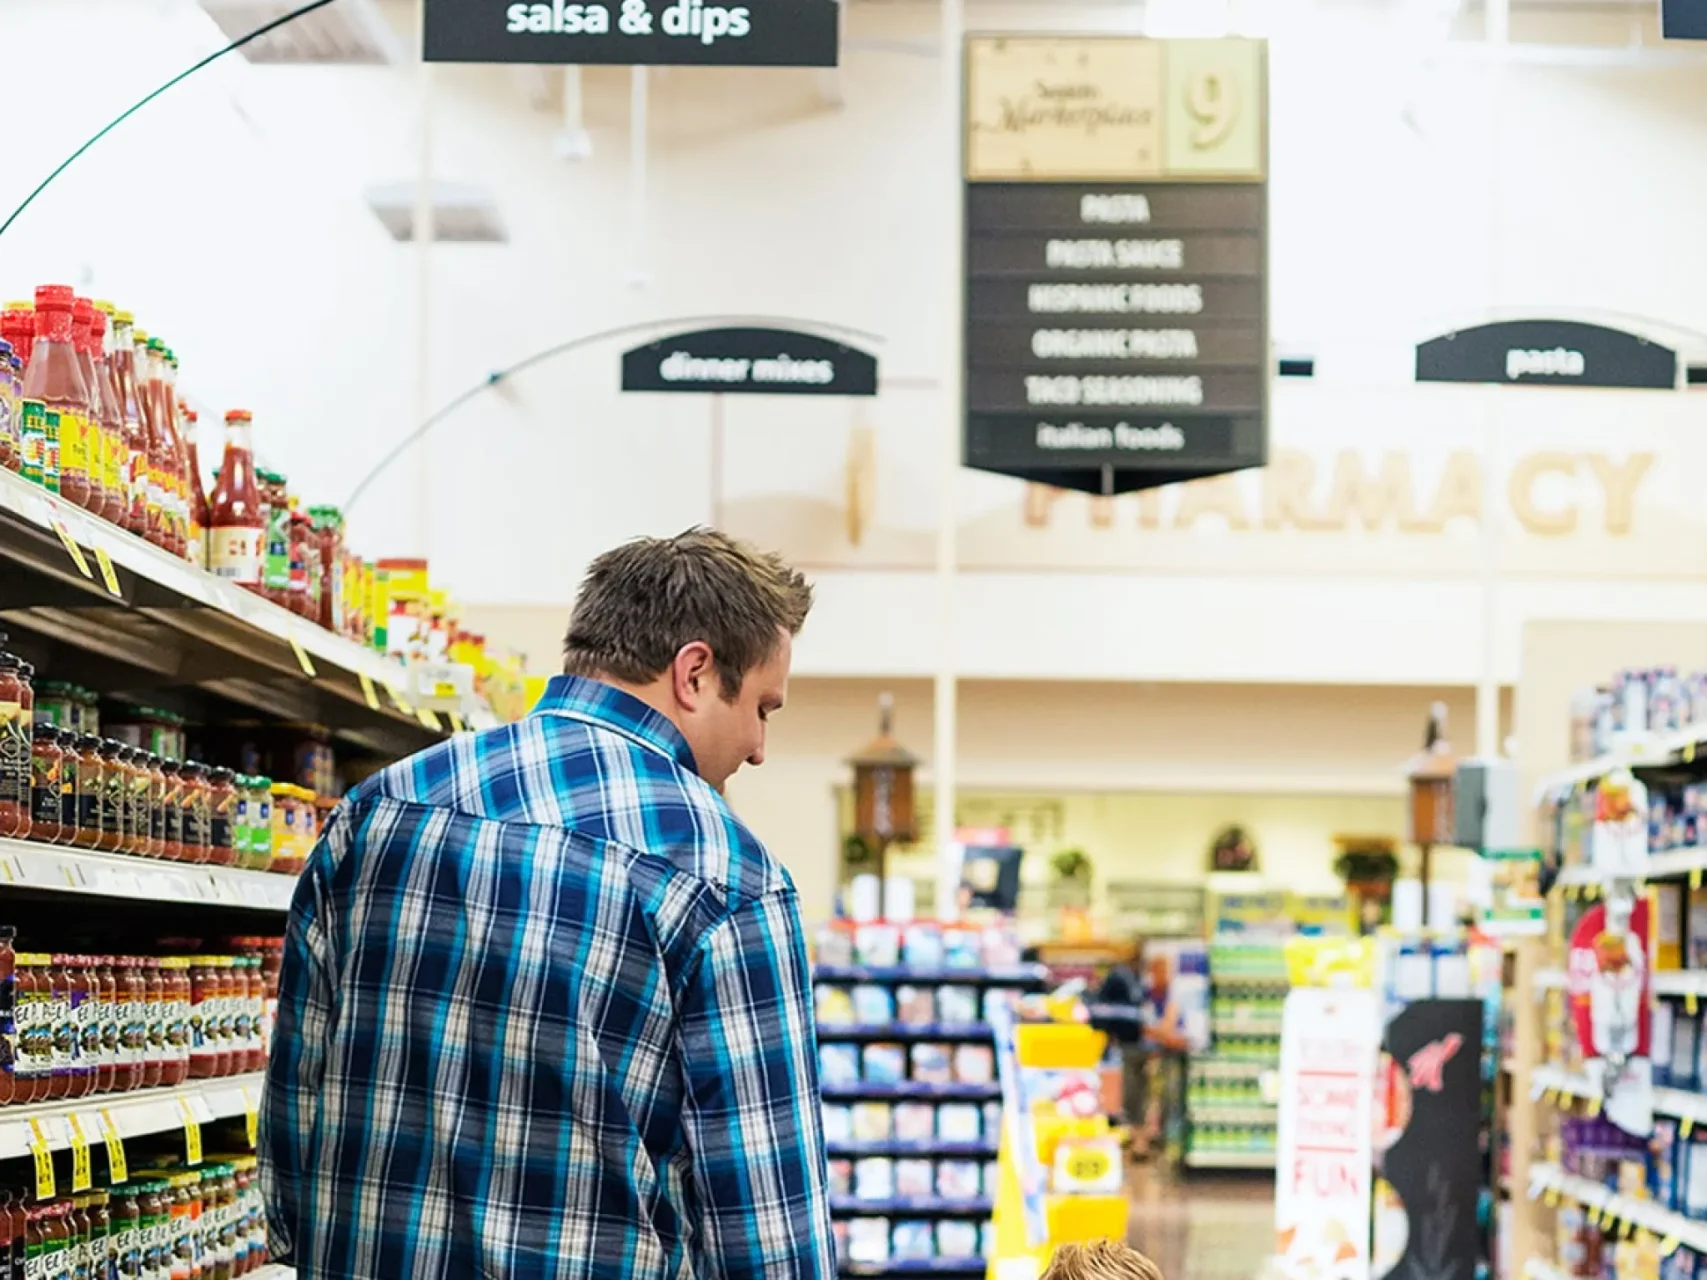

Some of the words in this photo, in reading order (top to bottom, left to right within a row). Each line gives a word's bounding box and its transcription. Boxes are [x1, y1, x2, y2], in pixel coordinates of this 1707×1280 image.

[506, 0, 609, 33] salsa
[618, 0, 653, 35] &
[661, 0, 750, 45] dips
[1182, 68, 1242, 152] 9
[659, 351, 749, 382] dinner
[752, 353, 835, 384] mixes
[1505, 346, 1585, 380] pasta
